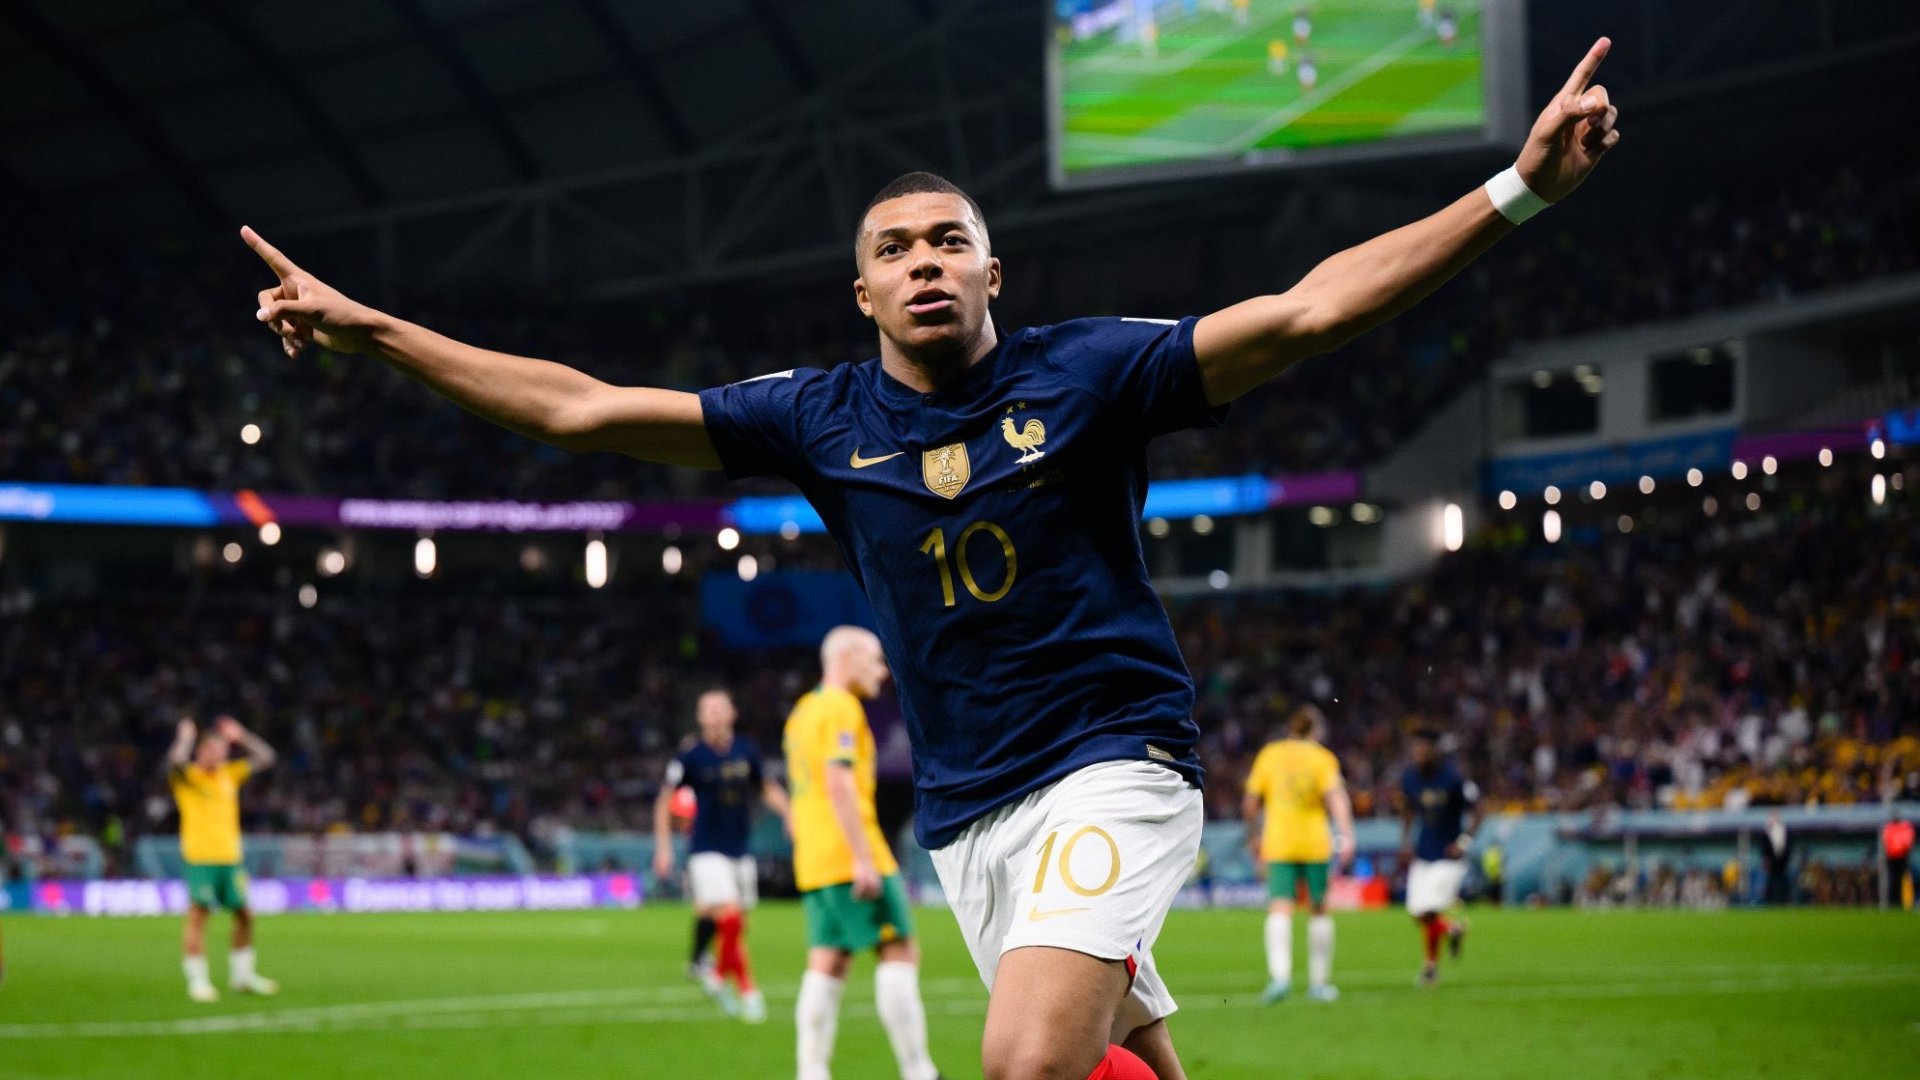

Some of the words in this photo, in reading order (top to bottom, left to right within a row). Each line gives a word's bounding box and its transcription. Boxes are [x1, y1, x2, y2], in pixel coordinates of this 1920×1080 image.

[938, 475, 959, 485] FIFA
[919, 520, 1018, 606] 10
[1032, 825, 1121, 897] 10
